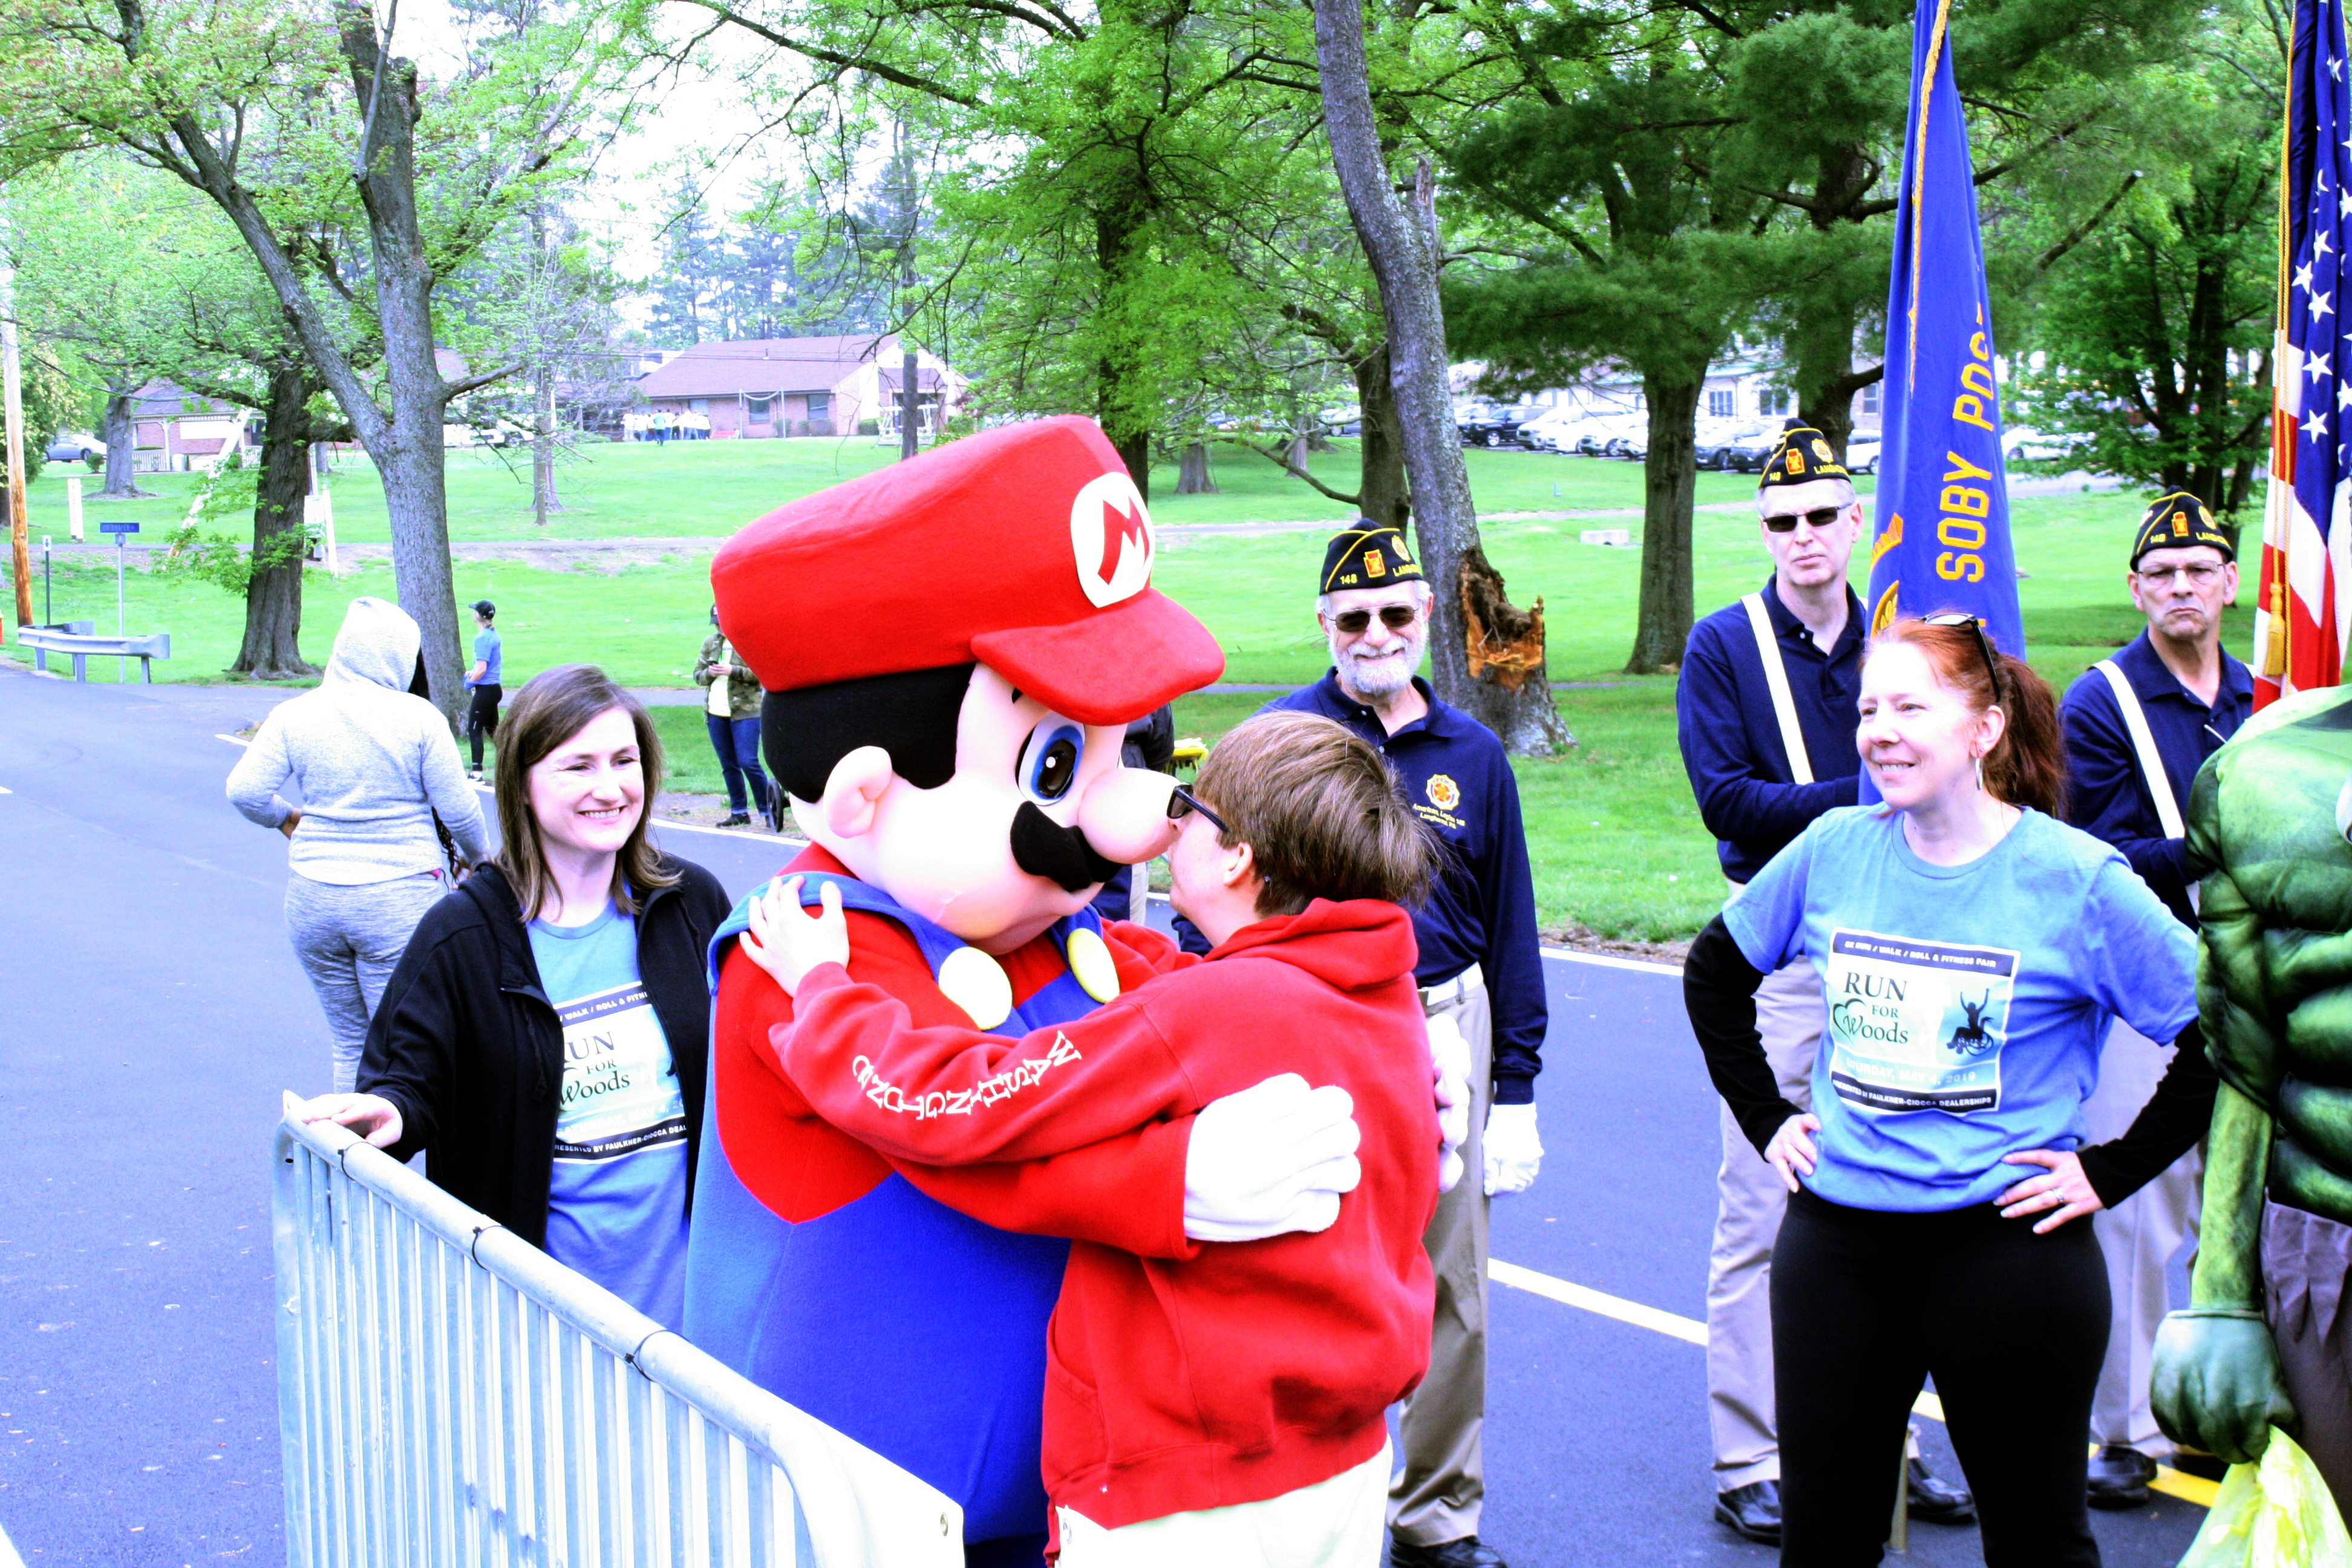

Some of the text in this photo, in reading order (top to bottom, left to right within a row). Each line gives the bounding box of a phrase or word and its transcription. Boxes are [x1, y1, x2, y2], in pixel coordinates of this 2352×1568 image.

[1936, 302, 1994, 582] SOBY POS
[1098, 495, 1150, 586] M
[1340, 573, 1357, 584] 148
[1879, 946, 1902, 956] WALK
[1909, 951, 1930, 960] ROLL
[1941, 955, 1974, 965] FITNESS
[1976, 958, 1996, 967] FAIR
[1843, 972, 1908, 1001] RUN
[565, 1008, 589, 1020] WALK
[596, 1000, 618, 1011] ROLL
[626, 991, 647, 1002] FITN
[1872, 1005, 1900, 1019] FOR
[1843, 1014, 1909, 1044] Woods
[564, 1030, 615, 1062] UN
[586, 1059, 618, 1074] FOR
[866, 1030, 1082, 1120] WASHINGTON
[1899, 1070, 1927, 1083] MAY
[1945, 1071, 1976, 1083] 2019
[560, 1070, 630, 1106] Woods
[1939, 1097, 1991, 1106] DEALERSHIPS
[605, 1128, 667, 1151] FAULKNER-CIOCCA
